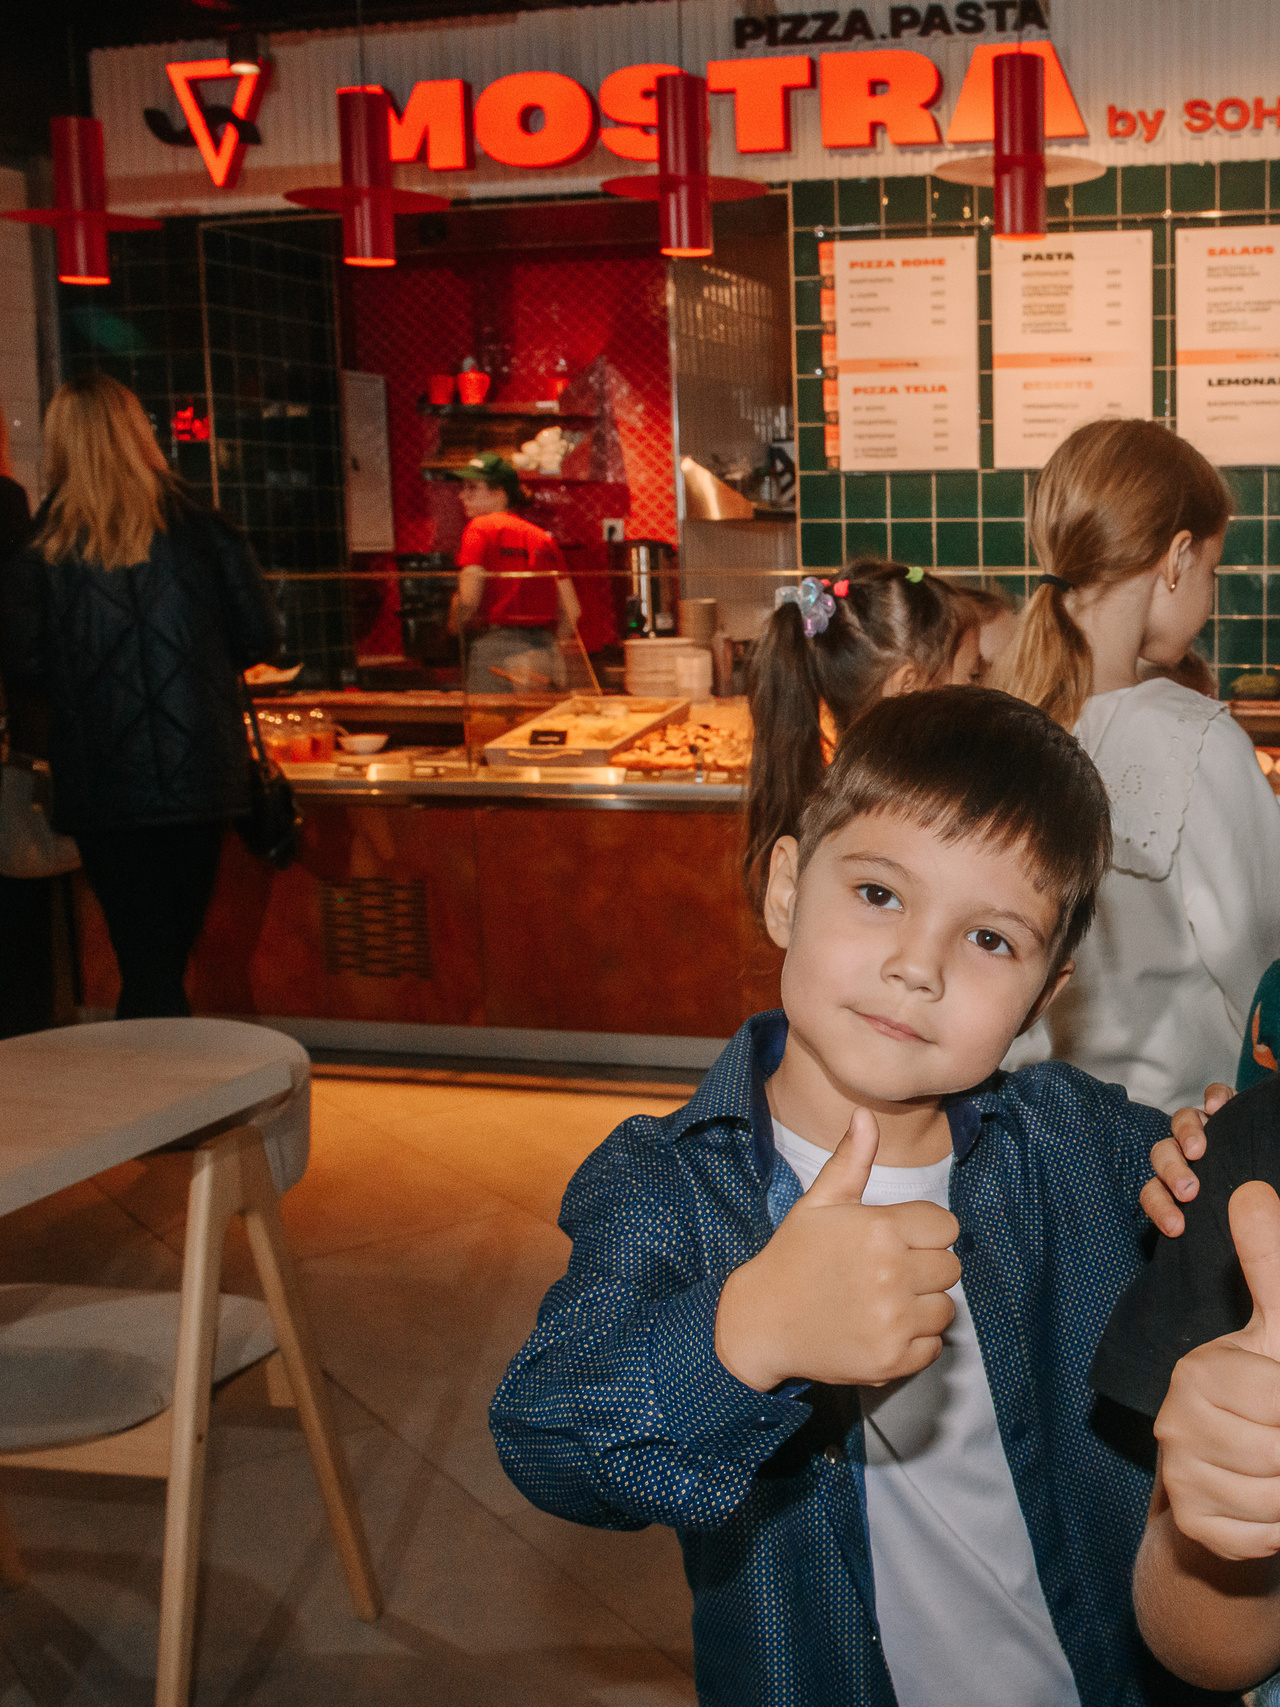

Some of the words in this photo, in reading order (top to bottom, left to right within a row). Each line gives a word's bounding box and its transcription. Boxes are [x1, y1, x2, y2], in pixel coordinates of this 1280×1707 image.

[337, 40, 1090, 170] MOSTRA
[1107, 104, 1166, 143] by
[1022, 252, 1075, 262] PASTA
[1207, 246, 1275, 257] SALADS
[849, 259, 895, 270] PIZZA
[853, 385, 898, 395] PIZZA
